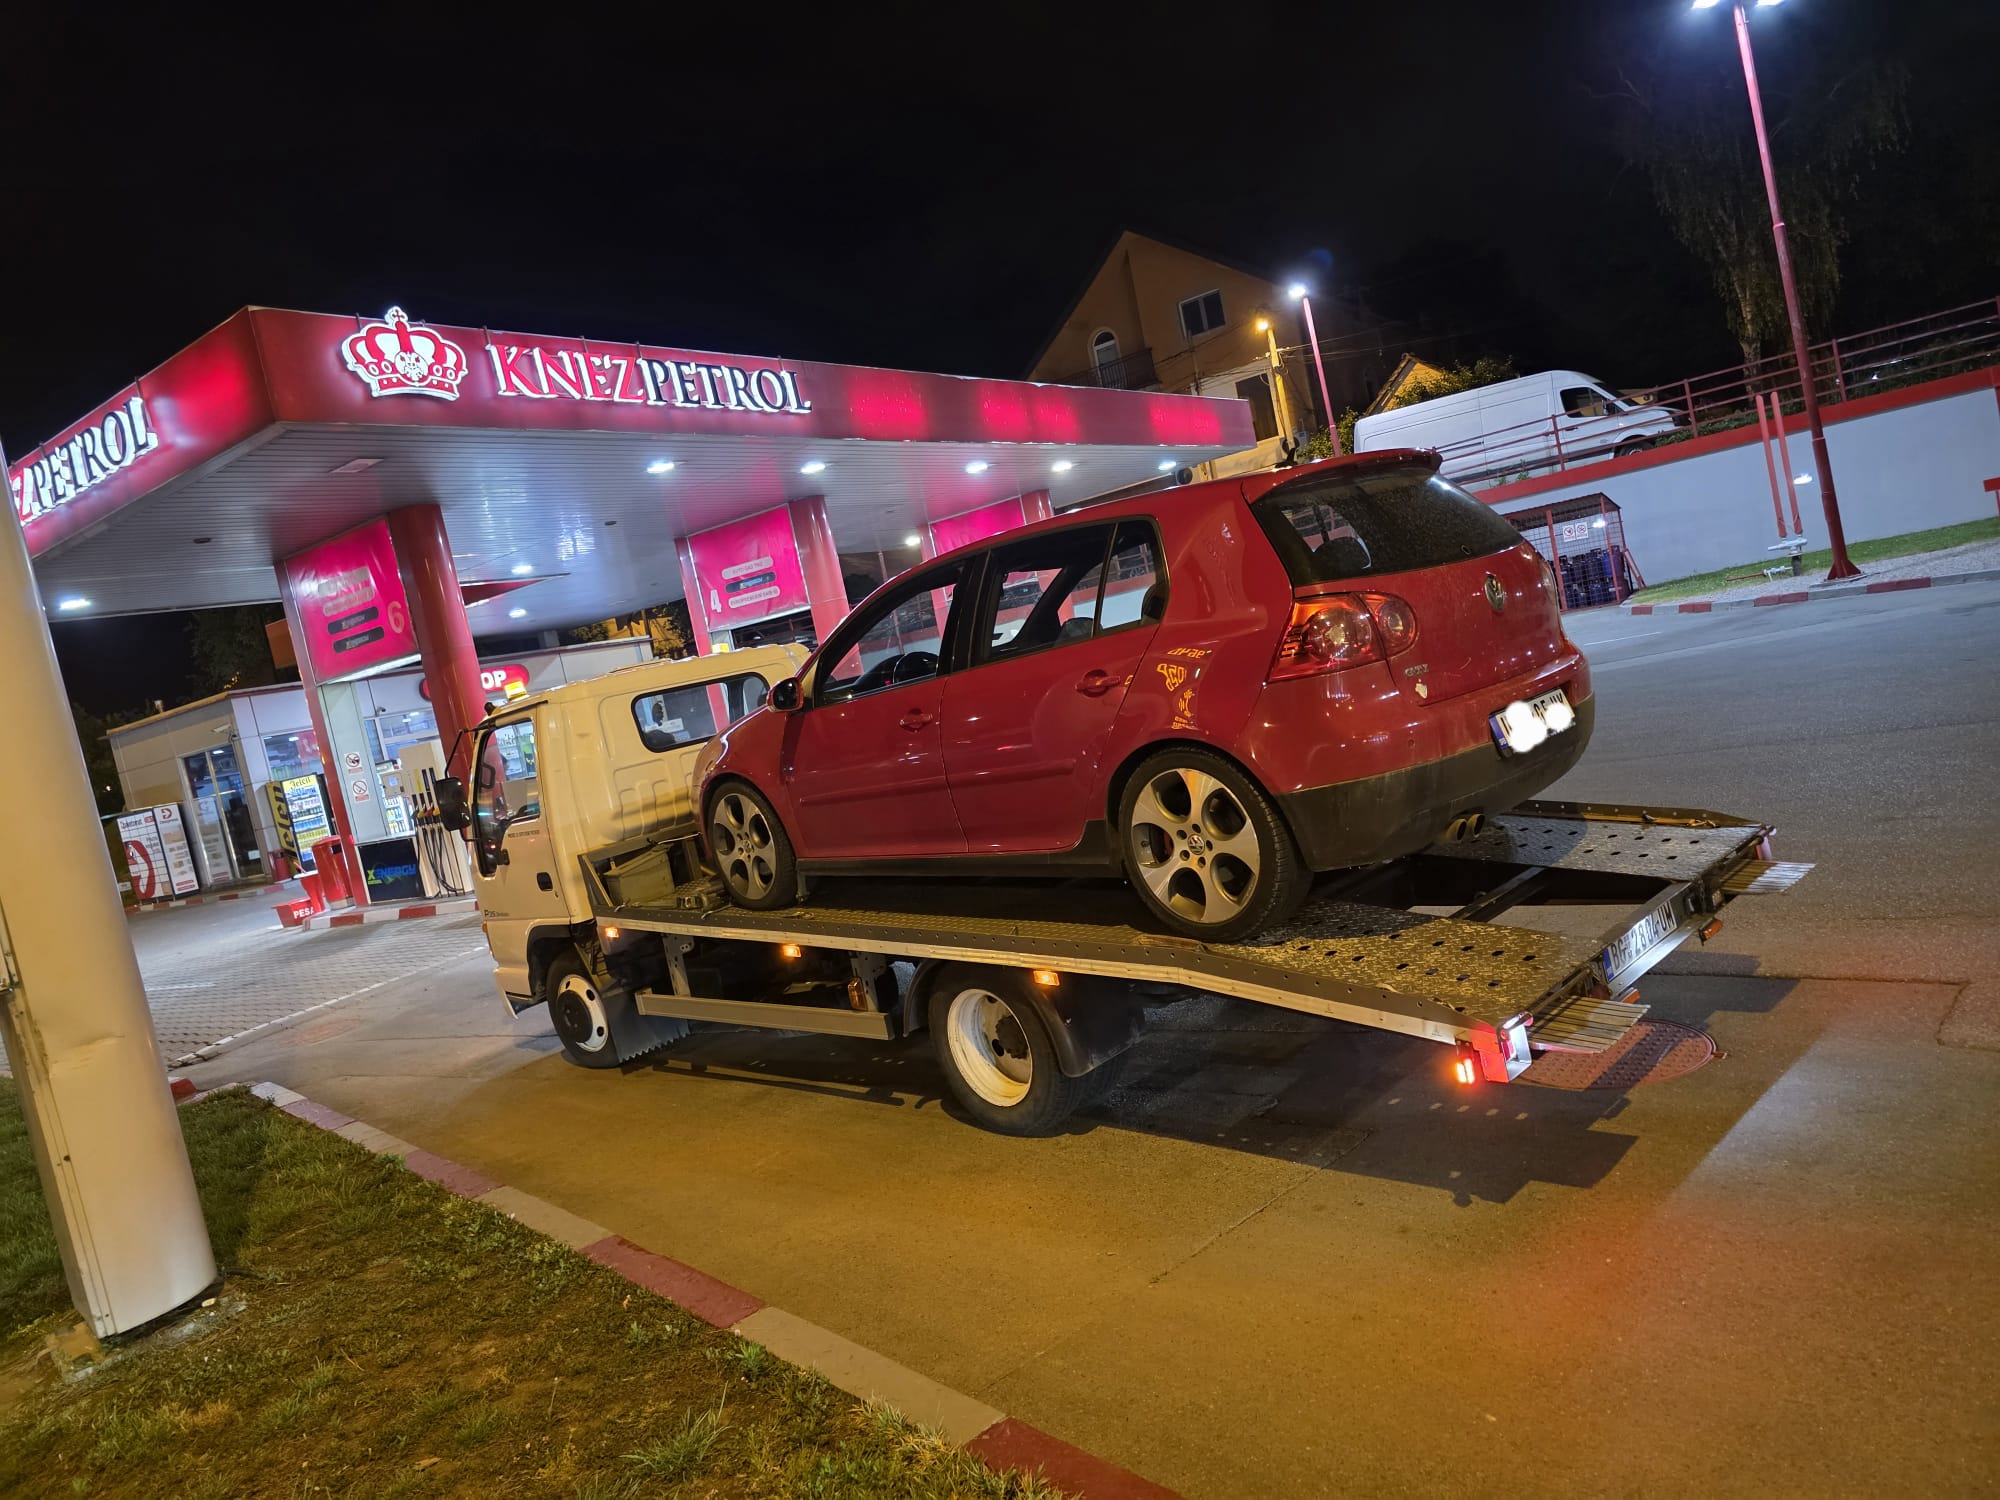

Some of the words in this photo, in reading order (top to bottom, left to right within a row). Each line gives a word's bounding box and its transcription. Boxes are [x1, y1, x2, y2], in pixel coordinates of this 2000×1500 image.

[710, 589, 722, 613] 4
[387, 601, 405, 634] 6
[1404, 663, 1429, 677] GTI
